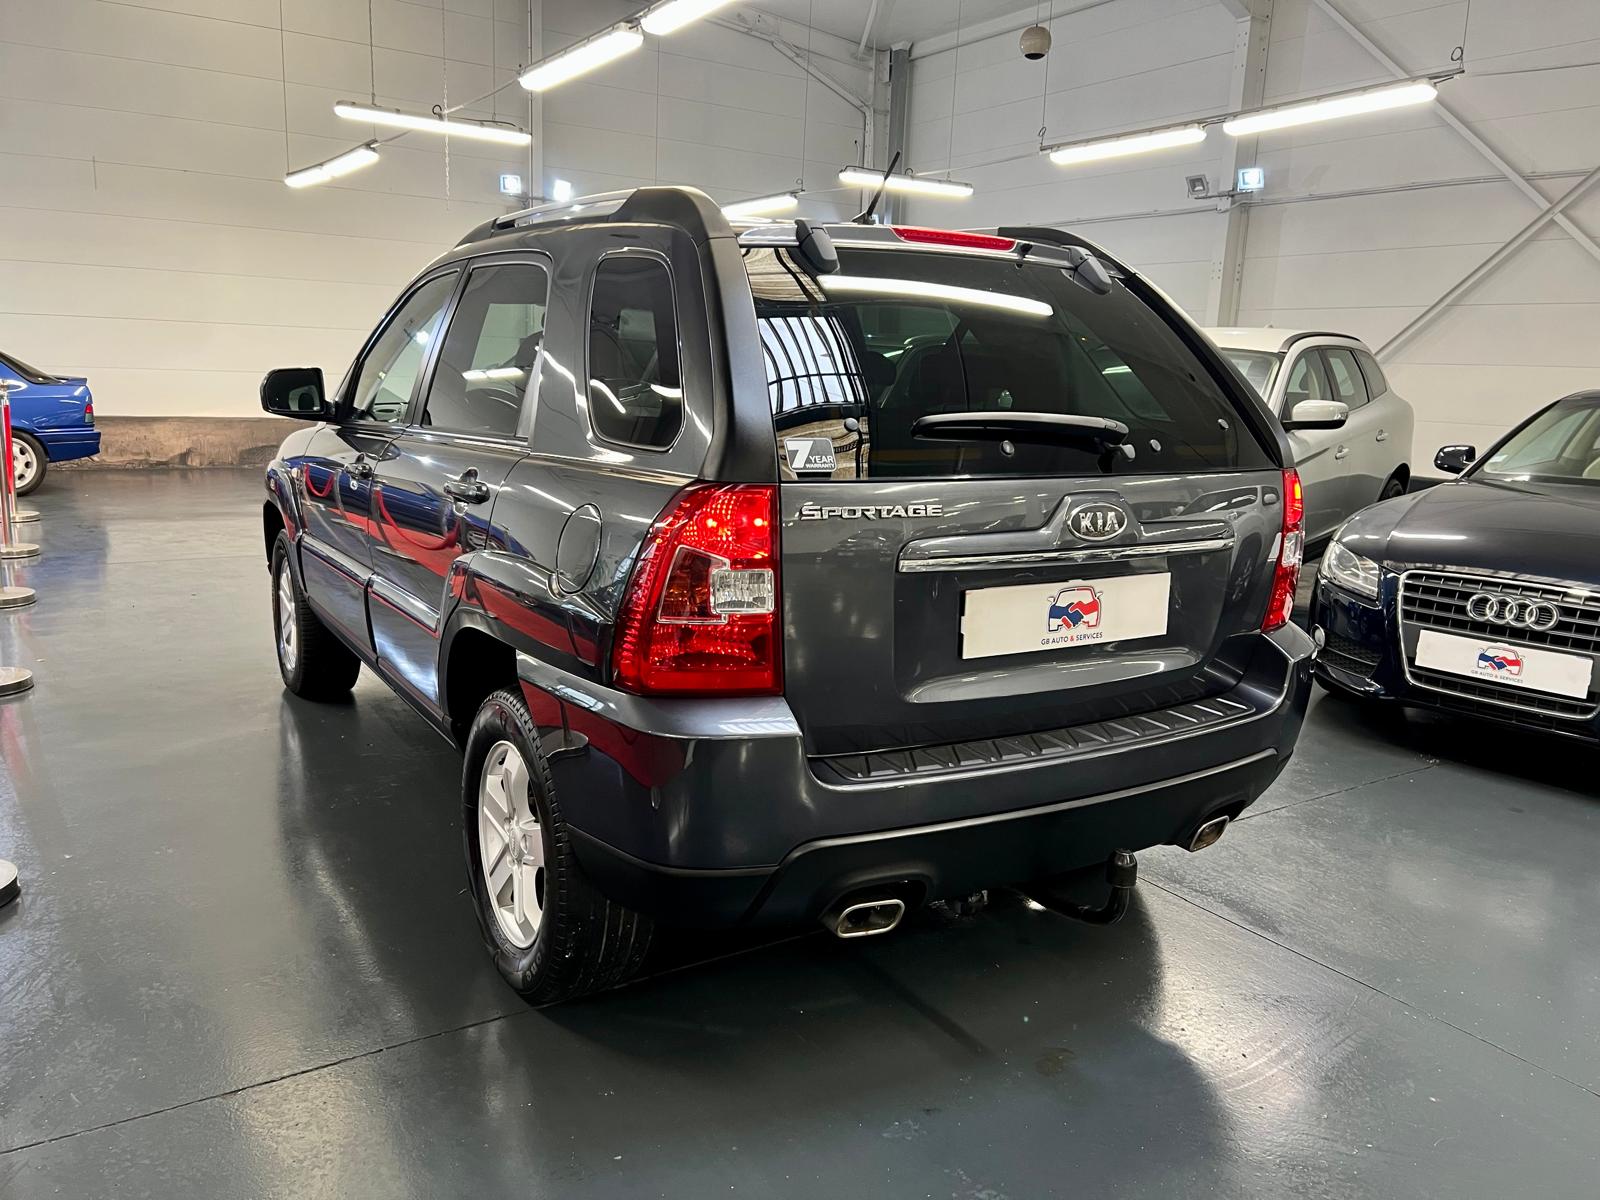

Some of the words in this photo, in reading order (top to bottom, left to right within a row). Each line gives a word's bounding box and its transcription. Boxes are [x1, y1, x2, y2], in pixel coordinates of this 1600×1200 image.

[786, 440, 814, 469] 7
[809, 455, 834, 464] YEAR
[800, 504, 943, 521] SPORTAGE
[1078, 511, 1120, 534] KIA
[1051, 636, 1069, 644] AUTO
[1075, 631, 1103, 641] SERVICES
